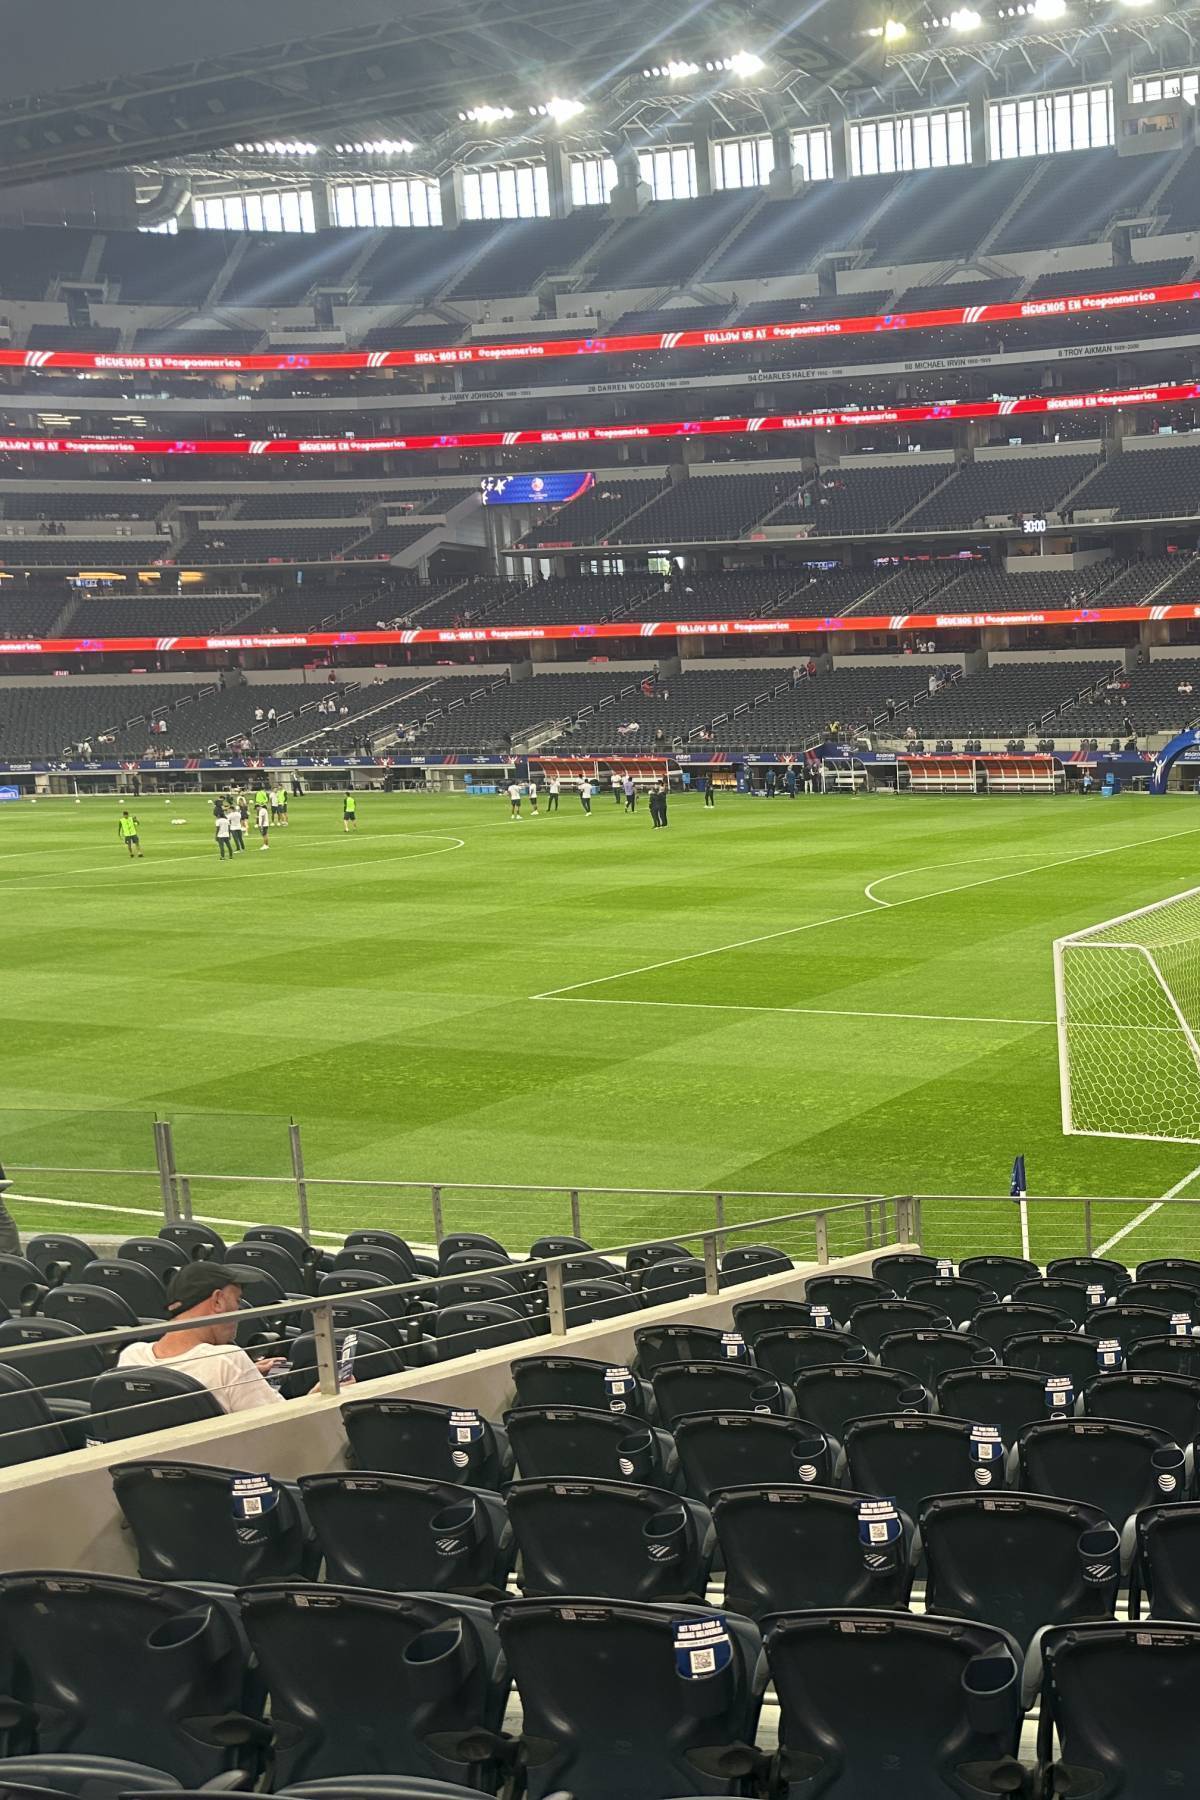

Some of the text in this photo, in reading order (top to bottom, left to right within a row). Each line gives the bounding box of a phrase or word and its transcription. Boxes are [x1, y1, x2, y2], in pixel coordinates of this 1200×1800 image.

[1068, 298, 1081, 311] EN
[704, 322, 840, 343] FOLLOW US AT @copaamerica
[459, 350, 472, 361] EM
[1065, 348, 1083, 357] TROY
[1084, 346, 1112, 355] AIKMAN
[149, 357, 163, 369] EN
[914, 361, 946, 369] MICHAEL
[947, 359, 966, 367] IRVIN
[758, 372, 791, 380] CHARLES
[792, 370, 816, 378] HALEY
[597, 383, 627, 391] DARREN
[470, 391, 503, 399] JOHNSON
[1085, 397, 1096, 406] EN
[782, 418, 812, 427] FOLLOW
[815, 417, 824, 425] US
[826, 416, 835, 425] AT
[47, 442, 58, 450] AT
[1023, 520, 1046, 532] 30:00
